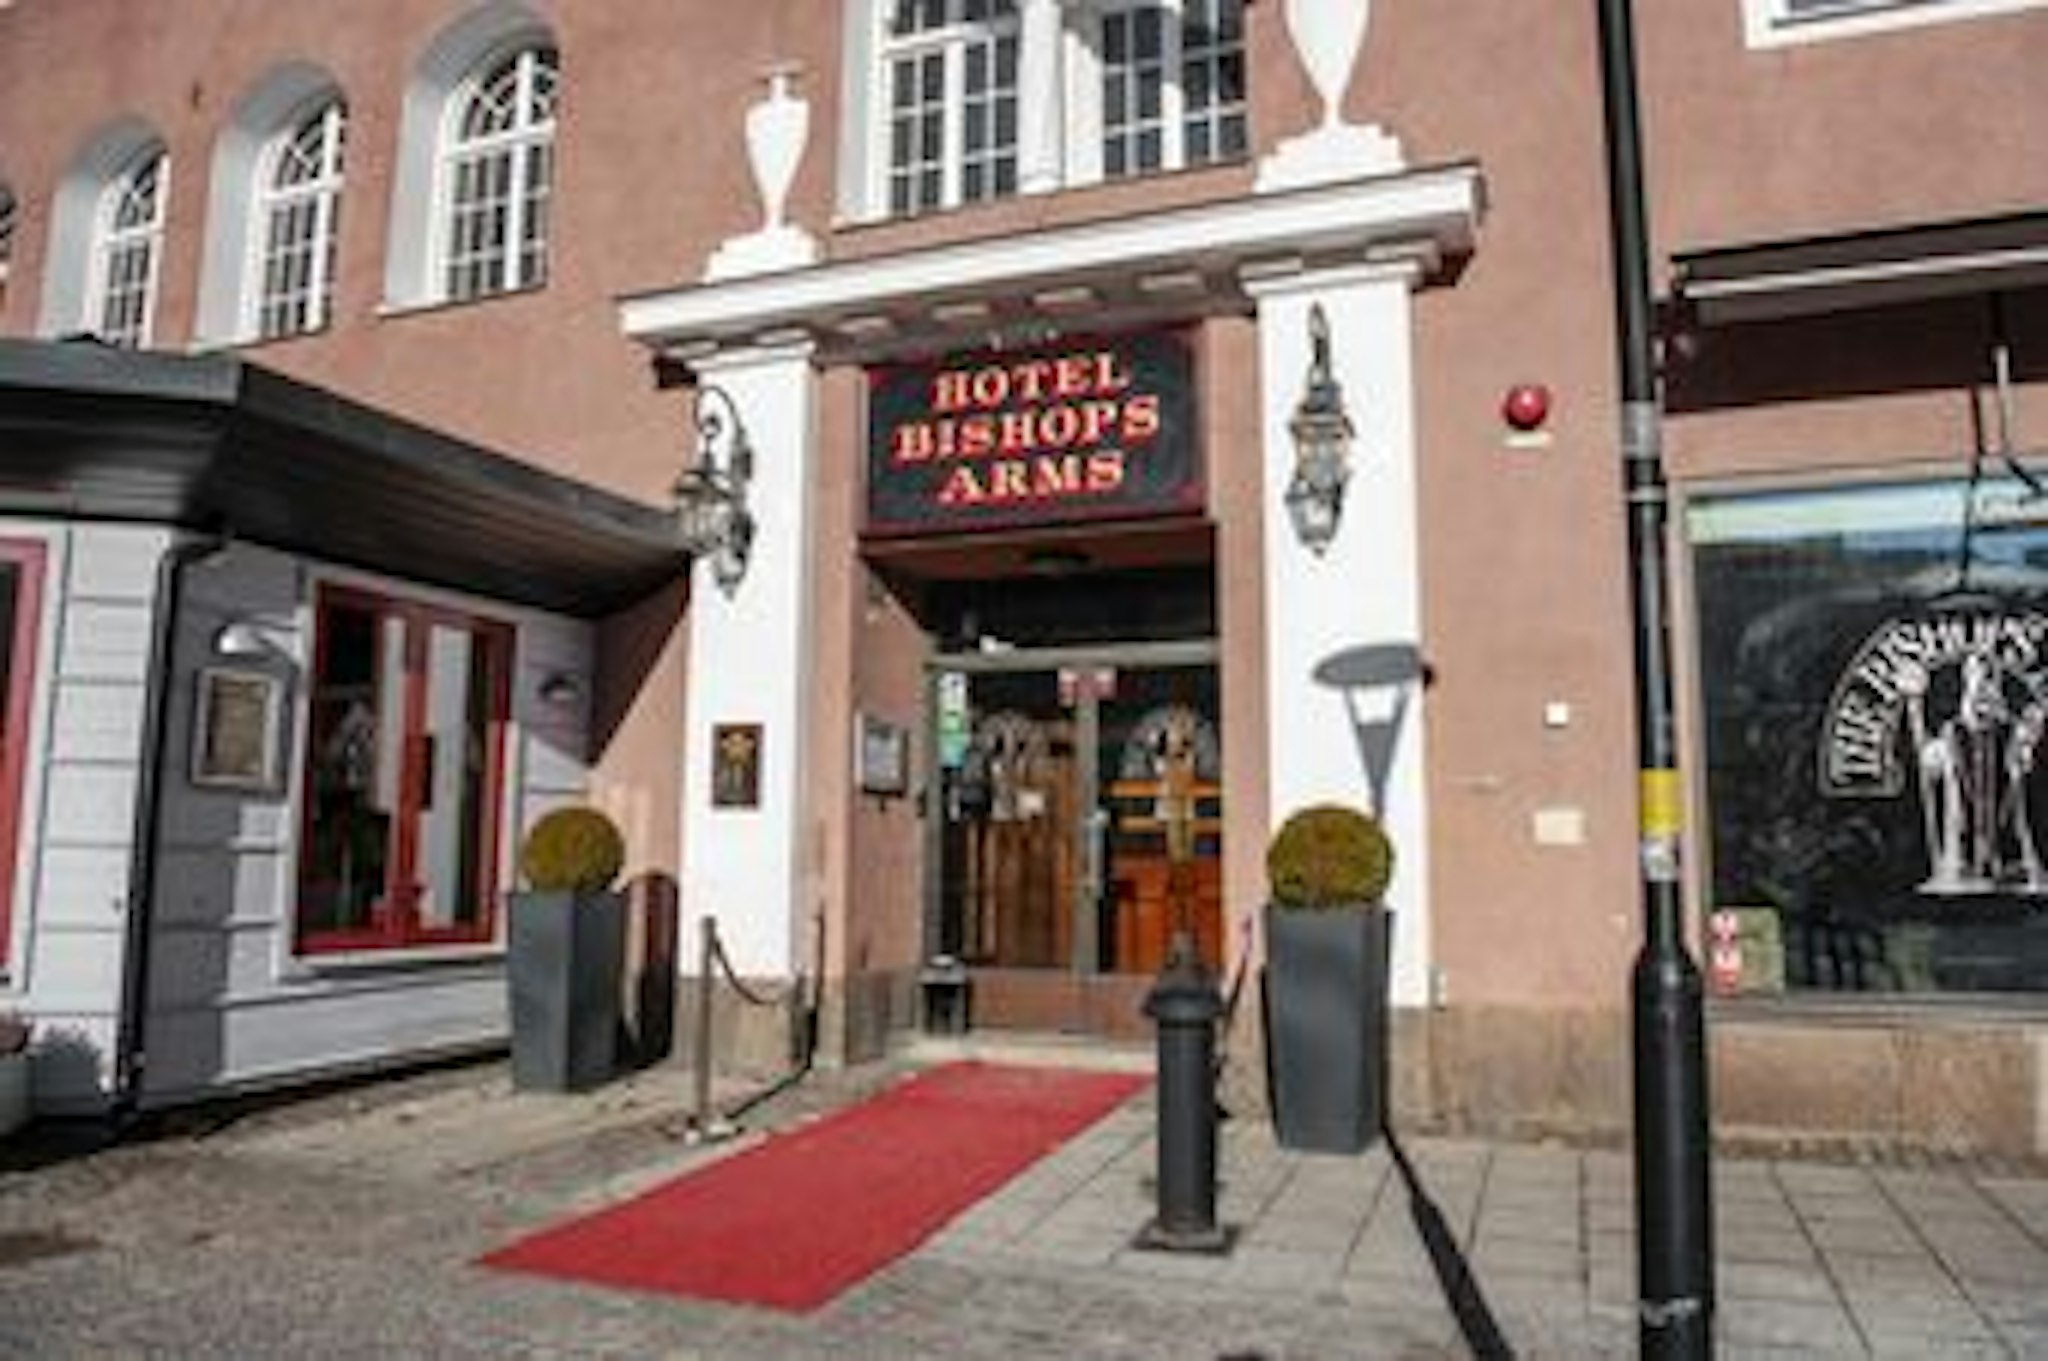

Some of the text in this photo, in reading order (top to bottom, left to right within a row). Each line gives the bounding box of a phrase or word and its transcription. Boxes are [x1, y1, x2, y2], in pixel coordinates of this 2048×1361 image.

[932, 352, 1129, 411] HOTEL
[890, 394, 1160, 462] BISHOPS
[938, 450, 1124, 503] ARMS
[1829, 690, 1890, 785] THE
